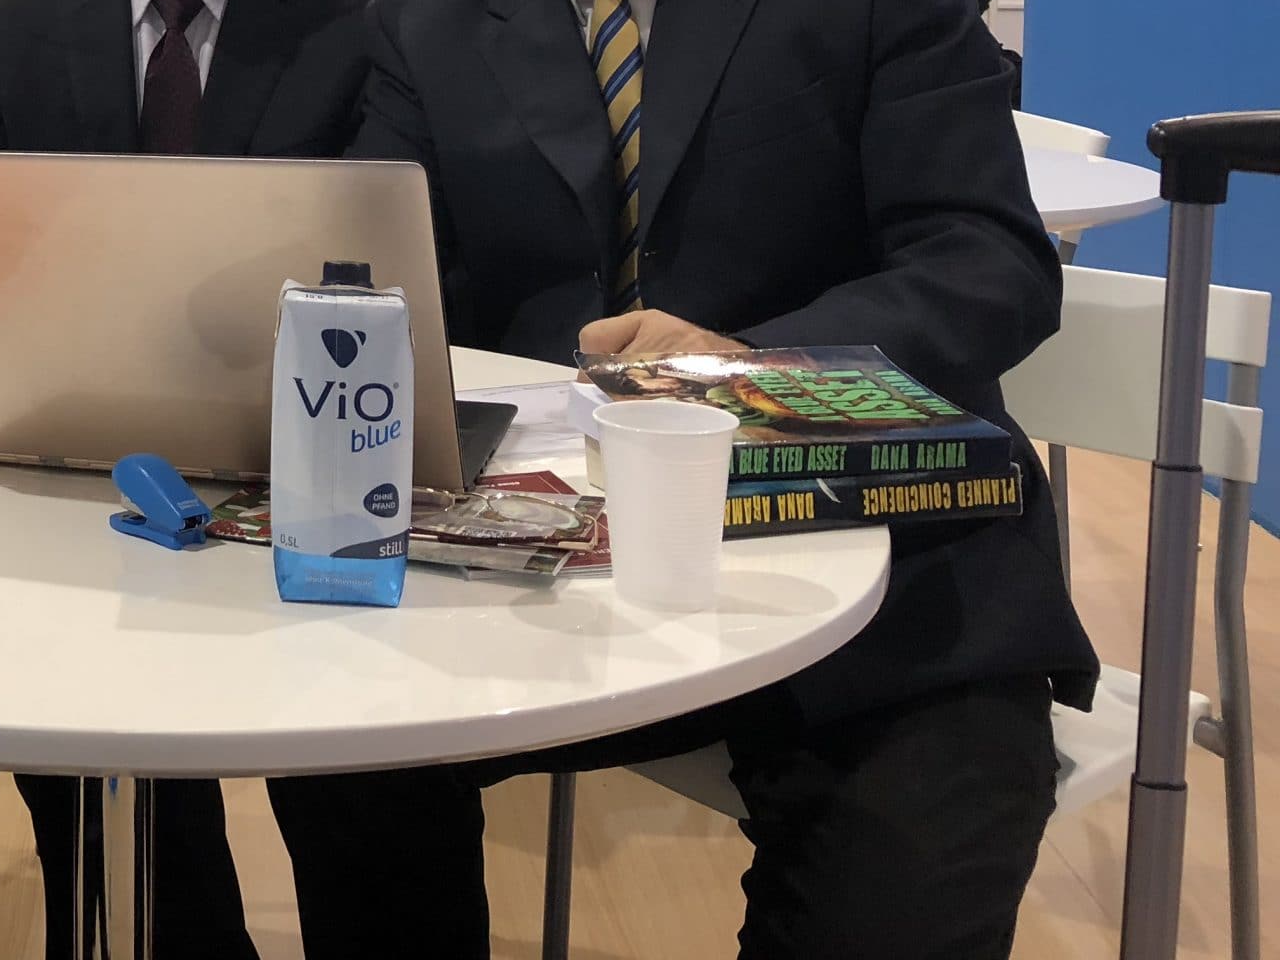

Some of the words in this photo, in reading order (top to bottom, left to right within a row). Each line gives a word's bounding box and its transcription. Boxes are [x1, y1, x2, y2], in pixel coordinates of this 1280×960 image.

[787, 369, 931, 419] ASSET
[351, 419, 401, 453] blue
[739, 445, 769, 475] BLUE
[773, 446, 803, 473] EYED
[807, 445, 848, 472] ASSET
[871, 443, 909, 471] DANA
[916, 442, 967, 469] ARAMA
[372, 502, 396, 511] PFAND
[373, 493, 393, 501] OHNE
[777, 492, 815, 521] DANA
[863, 481, 951, 516] COINCIDENCE
[958, 477, 1016, 508] PLANNED
[724, 495, 770, 526] ARAMA
[379, 541, 403, 557] still
